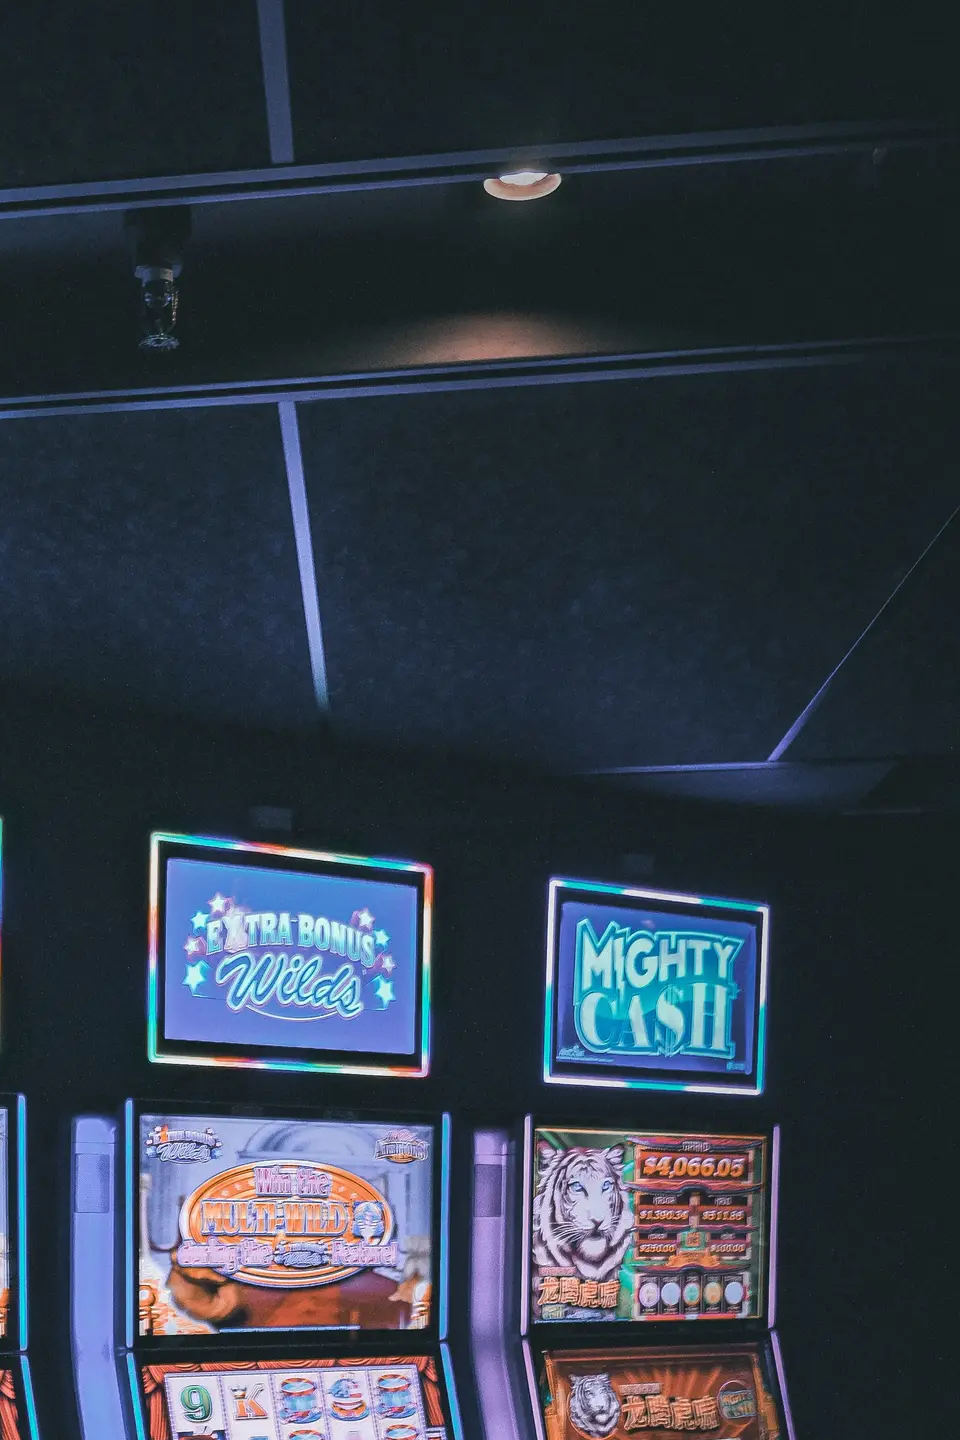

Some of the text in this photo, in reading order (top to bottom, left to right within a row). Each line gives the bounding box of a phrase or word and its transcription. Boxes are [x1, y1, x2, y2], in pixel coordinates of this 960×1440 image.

[206, 911, 377, 968] EXTRA BONUS
[577, 917, 745, 991] MIGHTY
[215, 952, 364, 1019] Wilds
[253, 1166, 332, 1198] Win the
[643, 1156, 746, 1178] $4,066.05
[201, 1199, 349, 1236] MULTI-WILD
[179, 1384, 270, 1423] 9 K
